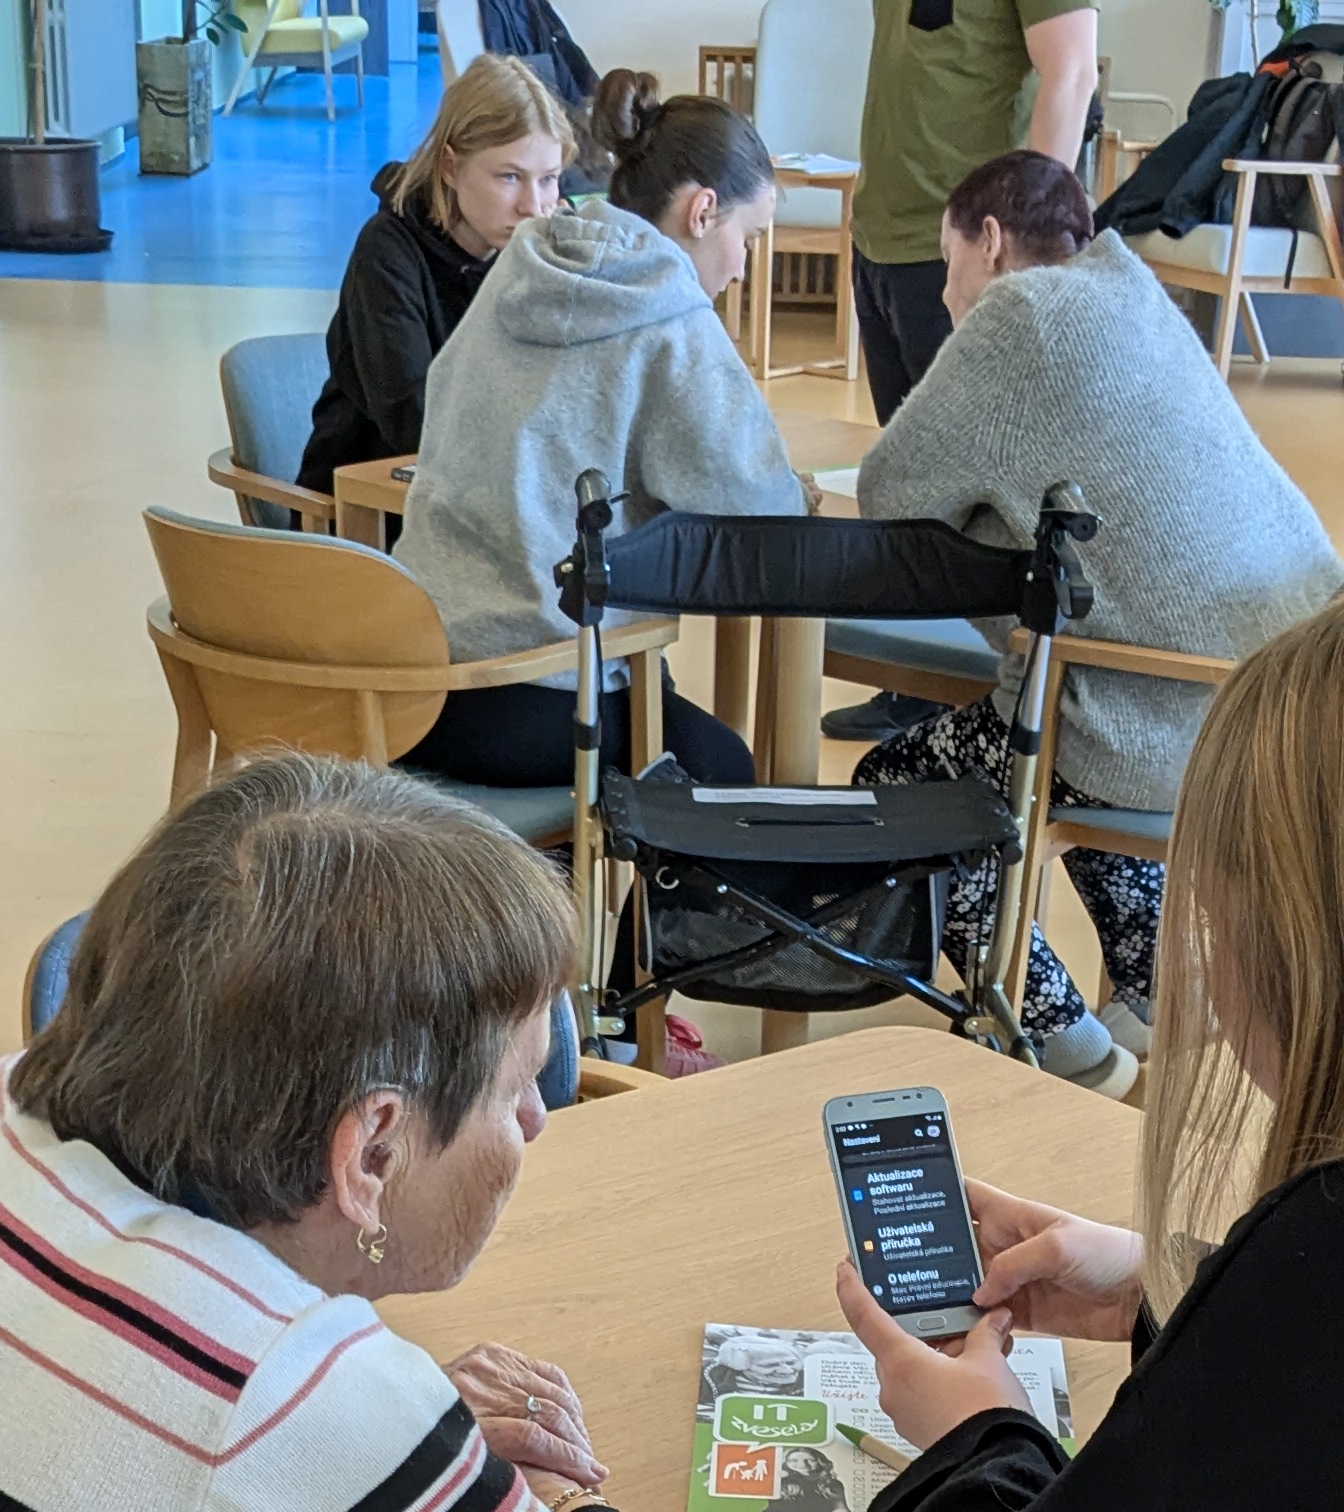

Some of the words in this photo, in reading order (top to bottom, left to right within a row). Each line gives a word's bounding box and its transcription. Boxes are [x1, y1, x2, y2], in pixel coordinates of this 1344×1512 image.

[867, 1169, 924, 1184] Aktualizace
[869, 1183, 913, 1196] softwaru
[877, 1220, 935, 1239] Uživatelská
[880, 1236, 922, 1252] příručka
[888, 1273, 897, 1285] O
[897, 1269, 939, 1284] telefonu
[753, 1403, 799, 1421] IT
